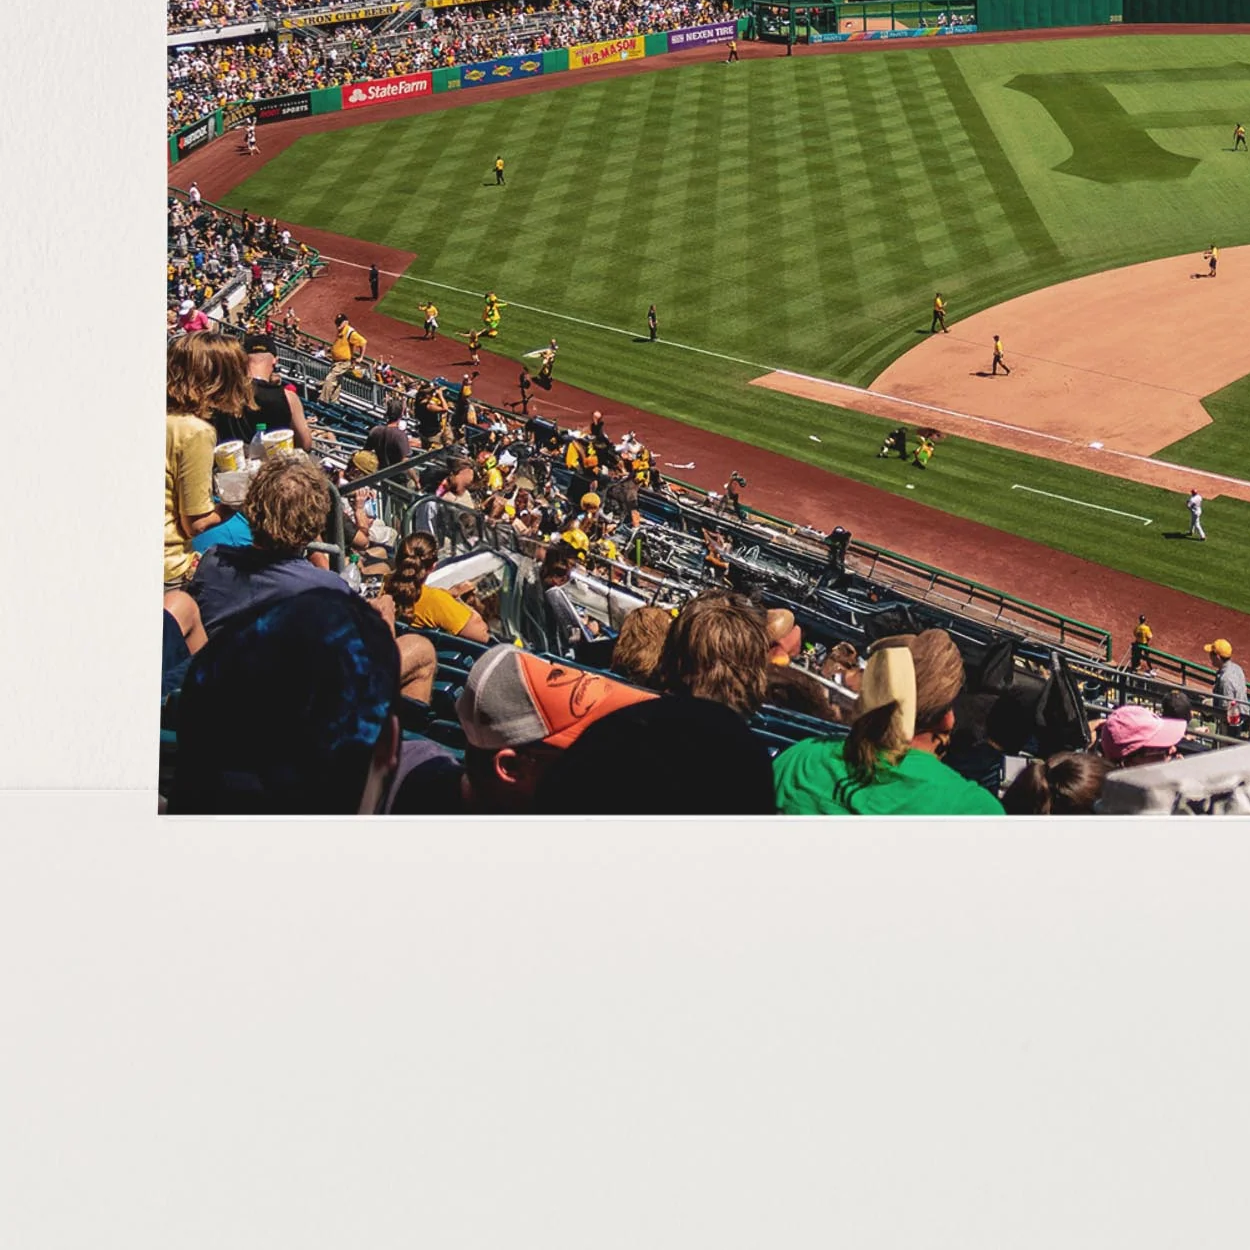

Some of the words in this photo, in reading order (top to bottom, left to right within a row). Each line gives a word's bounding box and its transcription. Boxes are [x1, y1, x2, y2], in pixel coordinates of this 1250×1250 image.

[303, 13, 334, 26] IRON
[335, 9, 361, 23] CITY
[363, 5, 394, 18] BEER
[686, 29, 713, 42] NEXEN
[715, 25, 734, 36] TIRE
[368, 79, 427, 100] StateFarm
[281, 104, 309, 115] SPORTS
